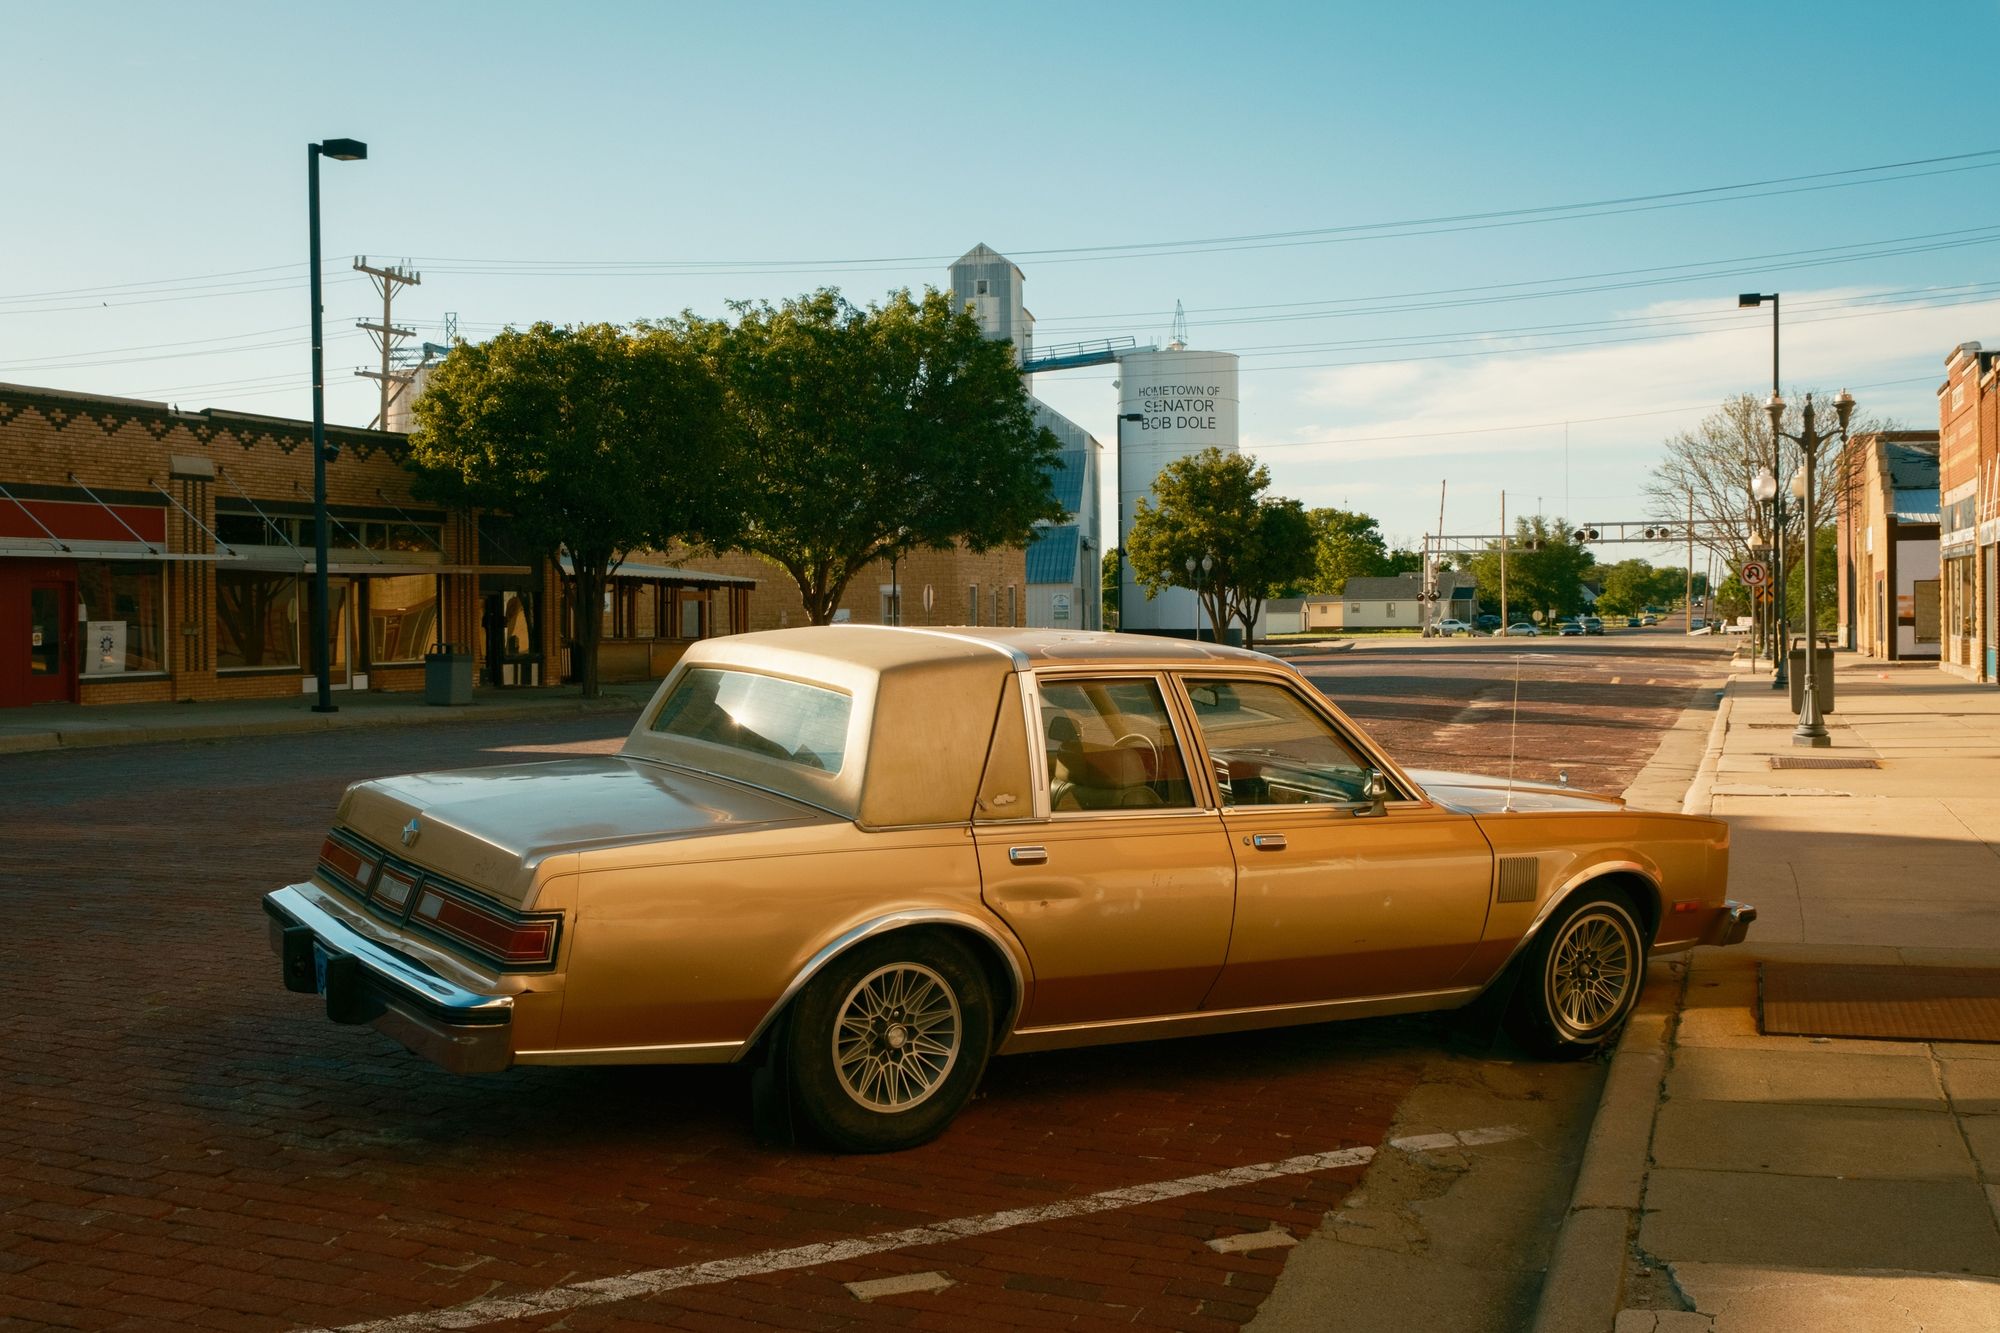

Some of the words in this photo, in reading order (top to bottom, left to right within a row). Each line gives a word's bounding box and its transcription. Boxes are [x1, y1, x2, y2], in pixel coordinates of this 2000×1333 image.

[1138, 385, 1204, 397] HOMETOWN
[1206, 385, 1220, 396] OF
[1144, 399, 1214, 413] SENATOR
[1141, 416, 1172, 430] BOB
[1176, 416, 1216, 430] DOLE
